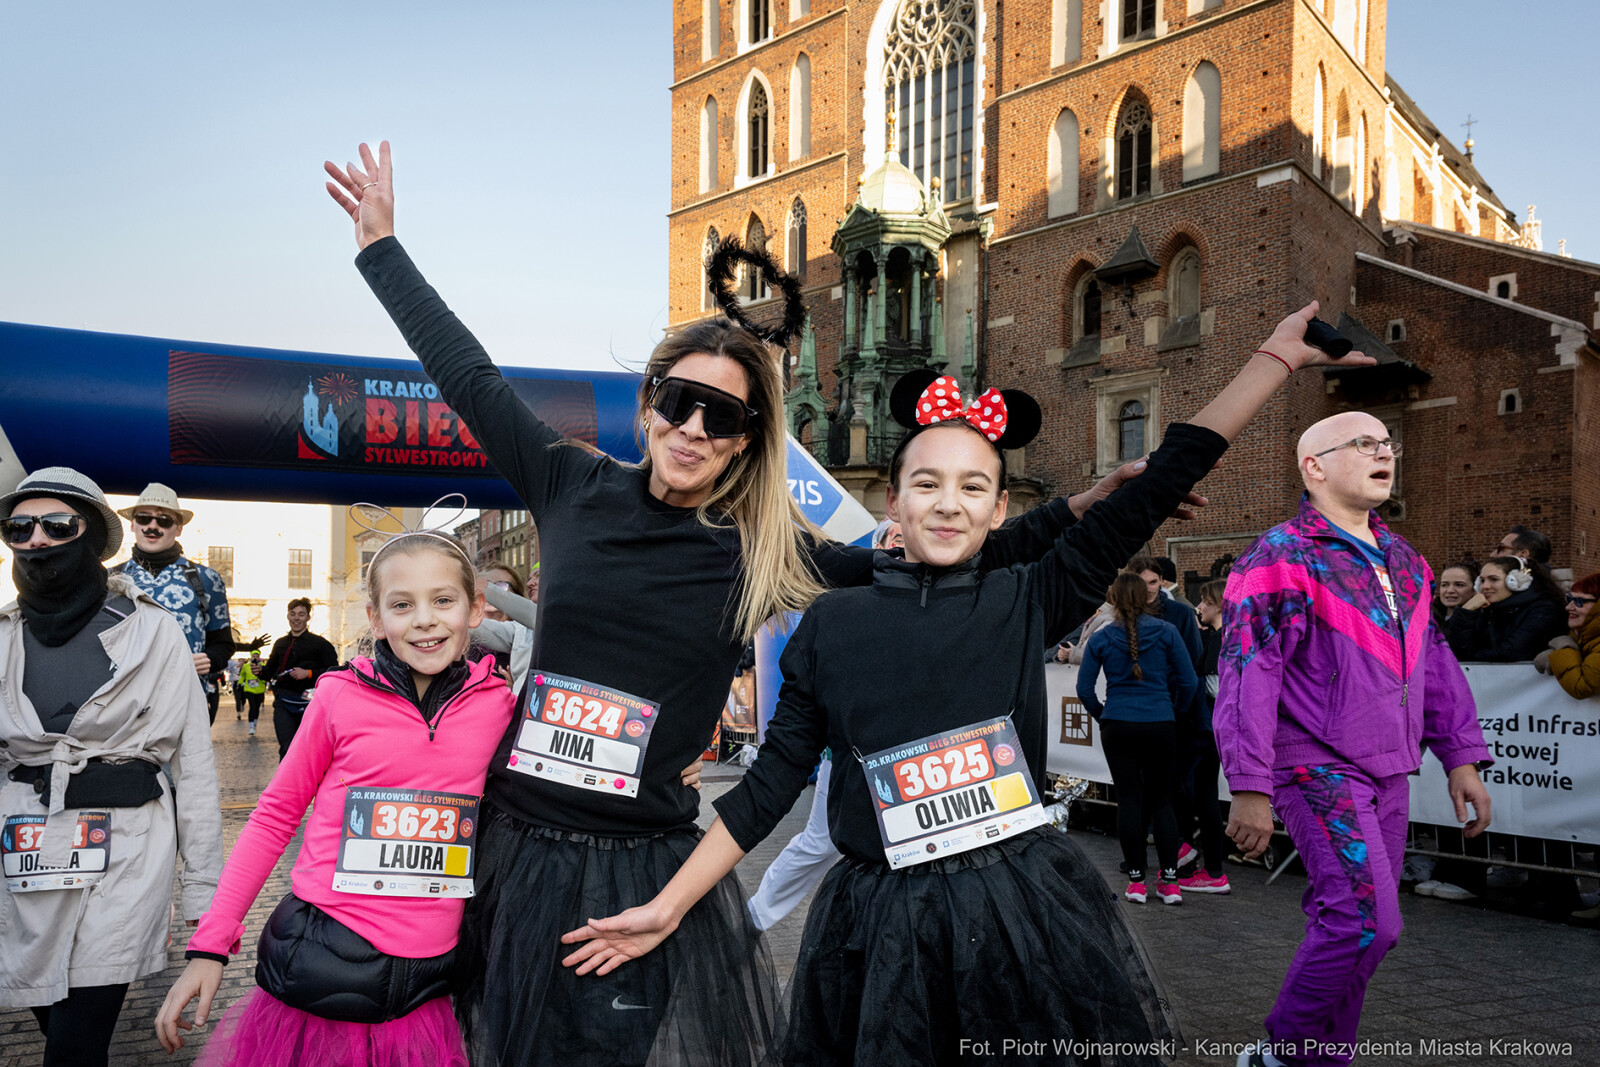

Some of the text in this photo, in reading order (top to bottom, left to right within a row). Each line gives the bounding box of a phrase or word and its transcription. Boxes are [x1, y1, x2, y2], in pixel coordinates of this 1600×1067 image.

[364, 447, 487, 467] SYLWESTROWY
[544, 676, 581, 692] KRAKOWSKI
[581, 685, 599, 696] BIEG
[546, 692, 622, 736] 3624
[1528, 714, 1600, 737] Infras
[549, 730, 595, 762] NINA
[867, 722, 1006, 769] 20. KRAKOWSKI BIEG SYLWESTROWY
[900, 743, 990, 797] 3625
[351, 791, 477, 807] 20. KRAKOWSKI BIEG SYLWESTROWY
[915, 786, 996, 830] OLIWIA
[19, 825, 83, 849] 374
[376, 805, 456, 840] 3623
[379, 844, 444, 870] LAURA
